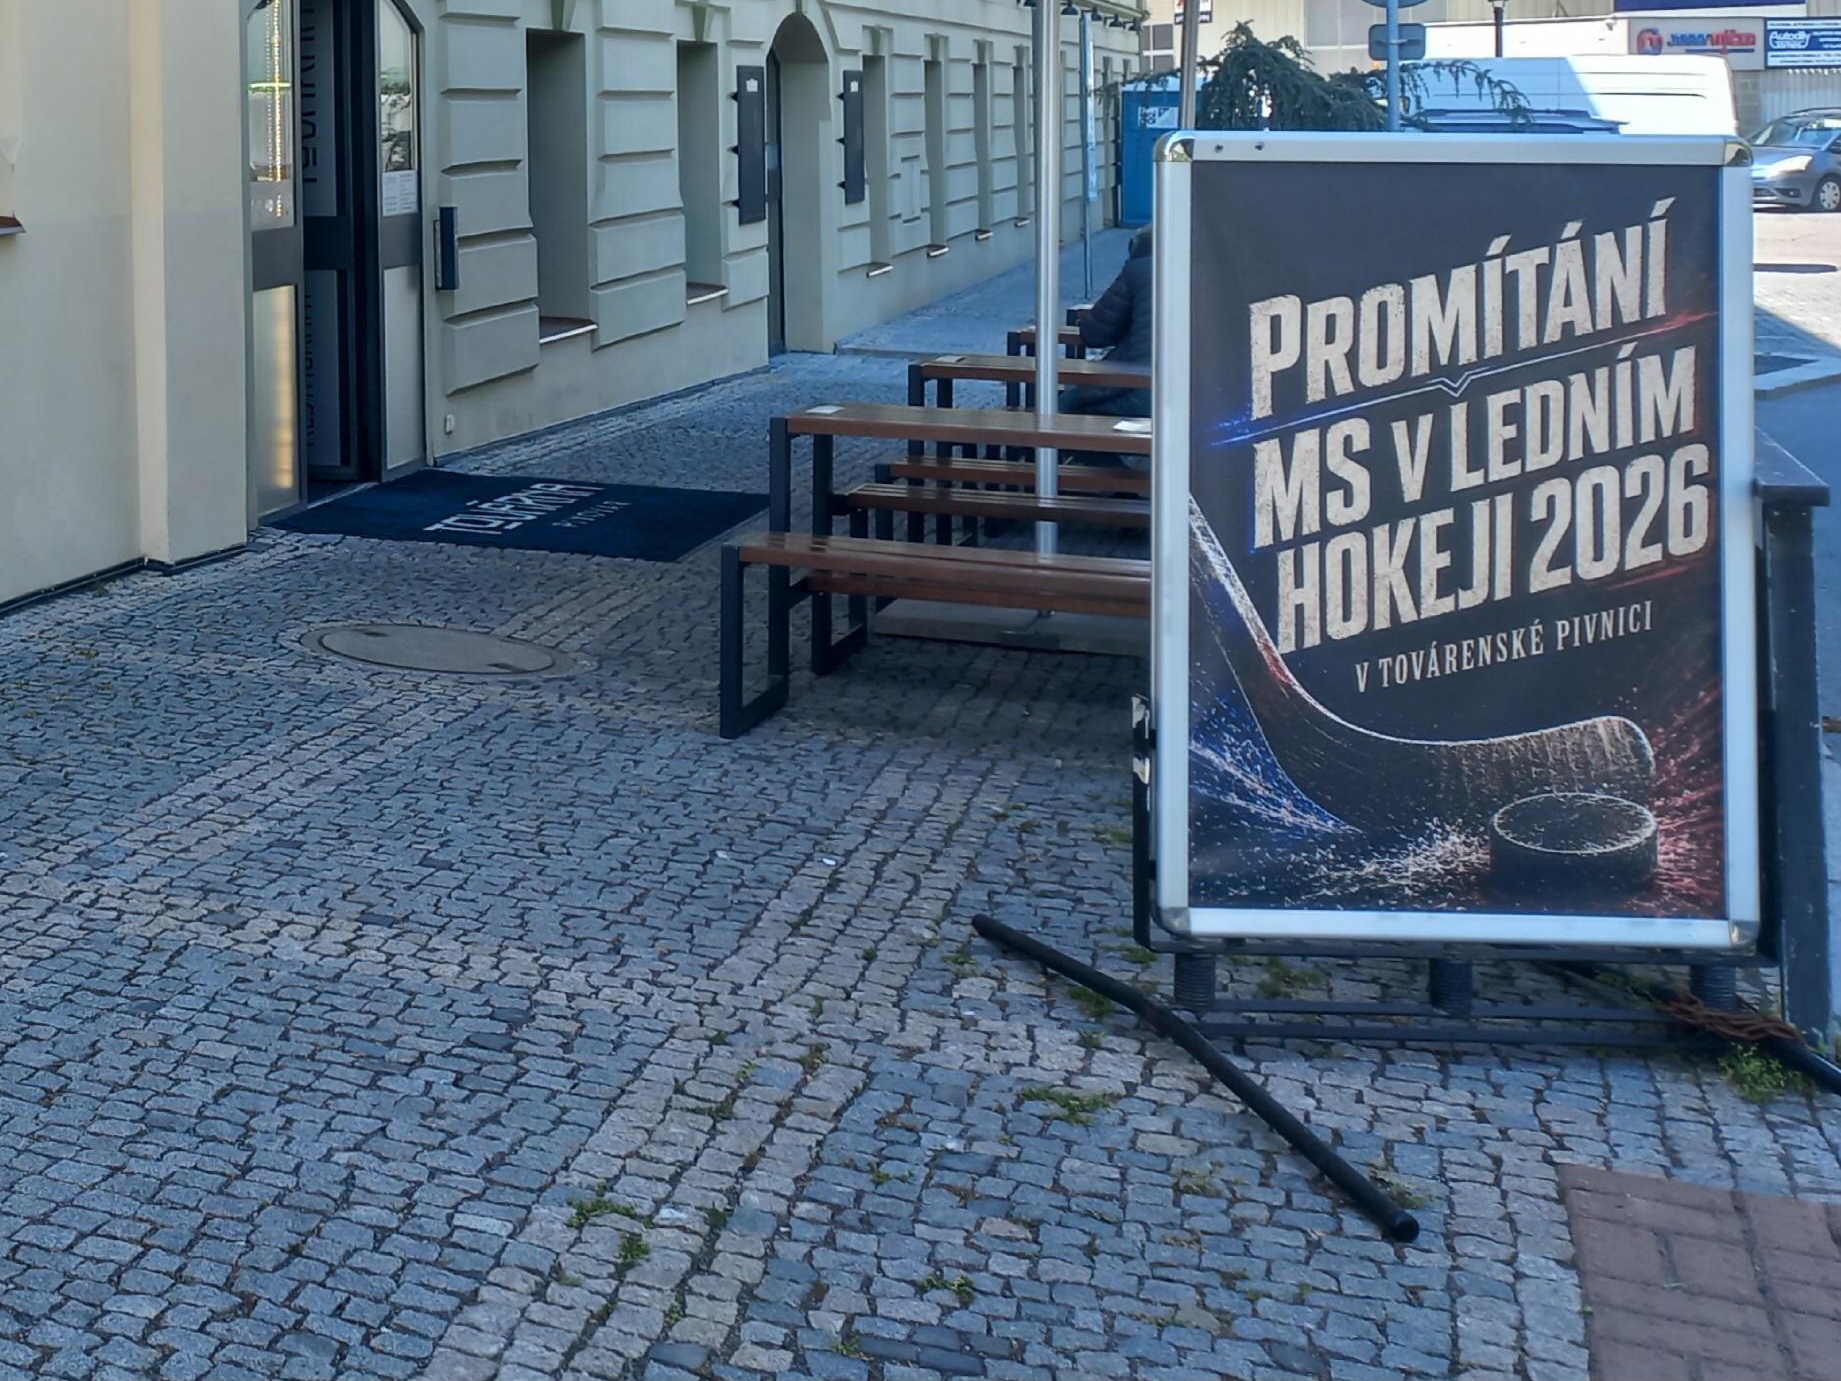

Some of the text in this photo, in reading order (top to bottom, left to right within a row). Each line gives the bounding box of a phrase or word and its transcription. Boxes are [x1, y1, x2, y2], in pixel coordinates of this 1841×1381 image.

[1247, 196, 1676, 419] PROMÍTÁNÍ
[1253, 342, 1695, 548] MS V LEDNÍM
[1276, 443, 1711, 656] HOKEJI 2026
[1355, 600, 1654, 694] V TOVÁRENSKÉ PIVNICI
